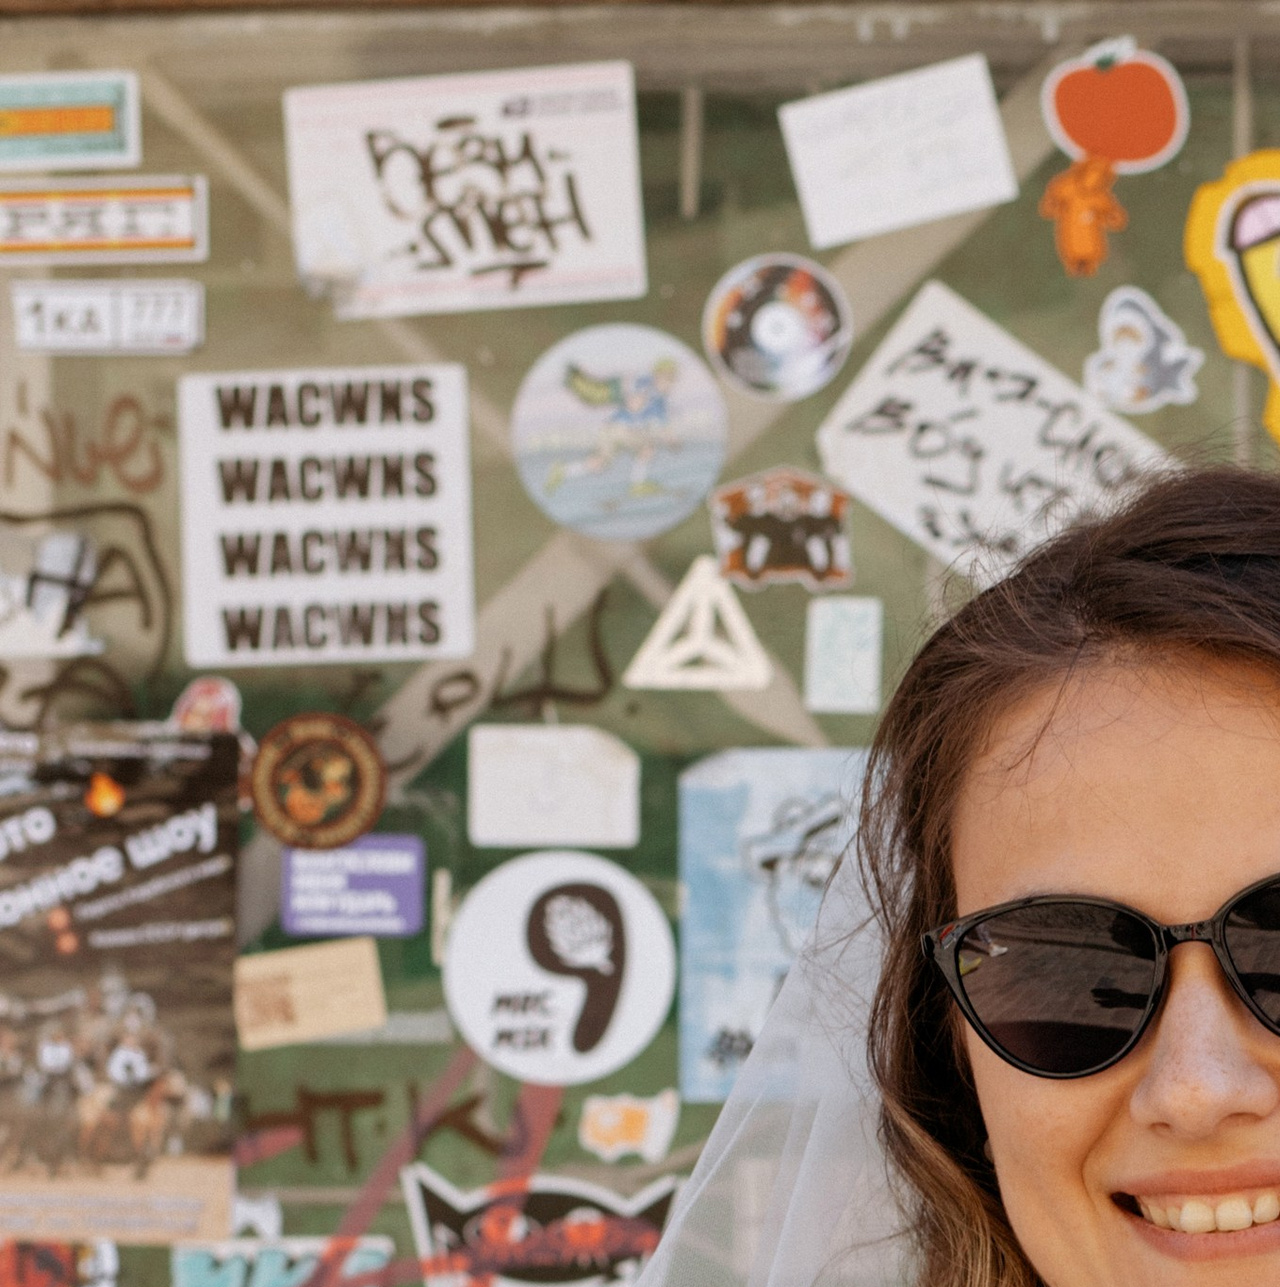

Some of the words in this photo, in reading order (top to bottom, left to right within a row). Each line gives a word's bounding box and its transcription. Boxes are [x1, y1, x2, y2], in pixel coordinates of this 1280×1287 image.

[216, 378, 435, 430] WACWNS
[218, 452, 437, 503] WACWNS
[220, 526, 439, 577] WACWNS
[222, 600, 441, 651] WACWNS
